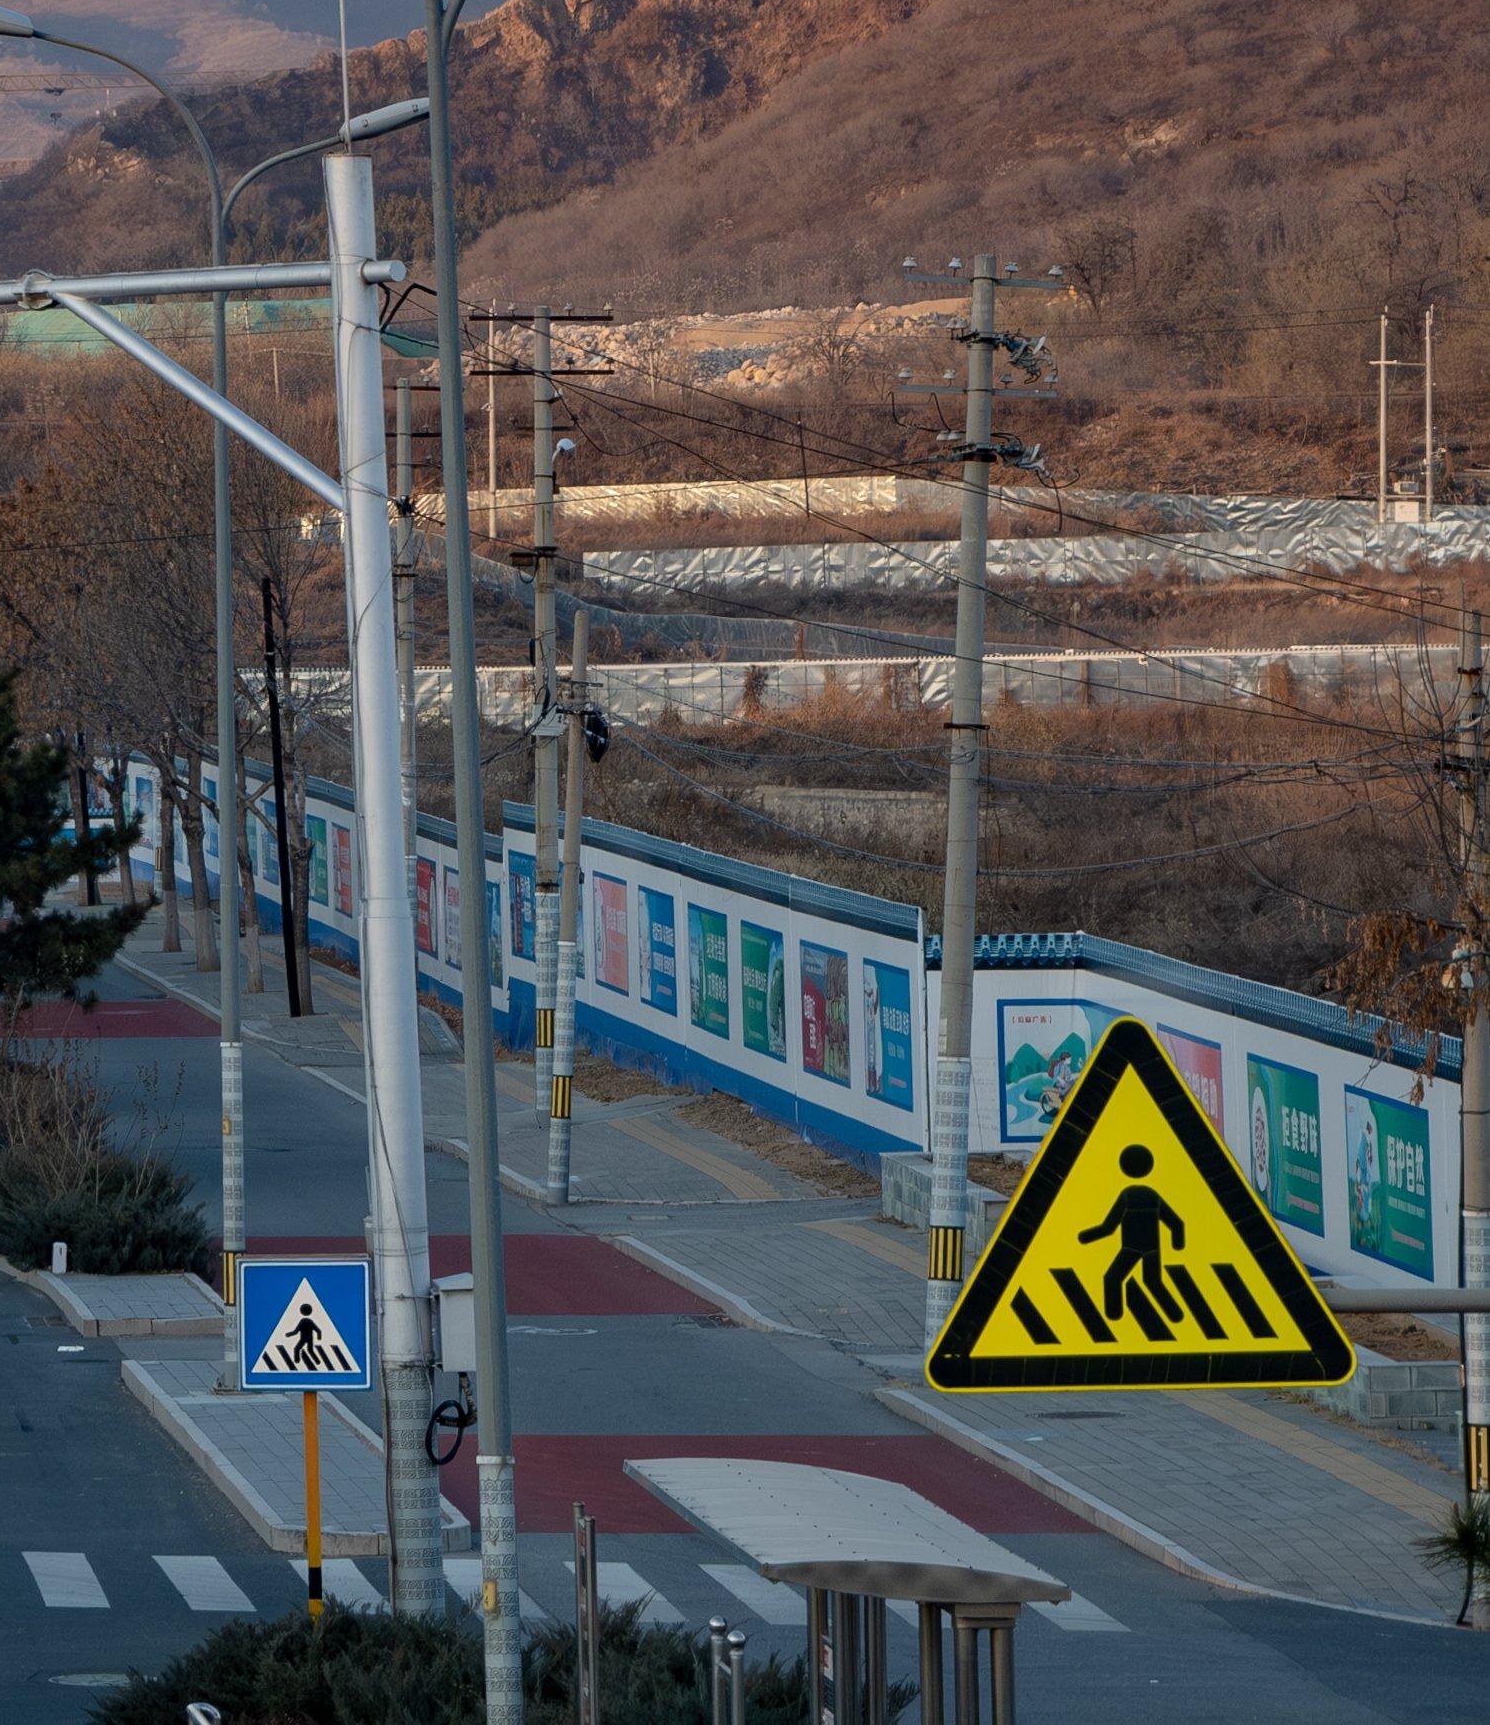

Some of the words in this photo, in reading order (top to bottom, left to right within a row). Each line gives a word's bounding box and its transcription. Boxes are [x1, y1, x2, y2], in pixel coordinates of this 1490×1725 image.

[1281, 1105, 1318, 1158] 拒食野味
[1387, 1134, 1426, 1196] 保护自然
